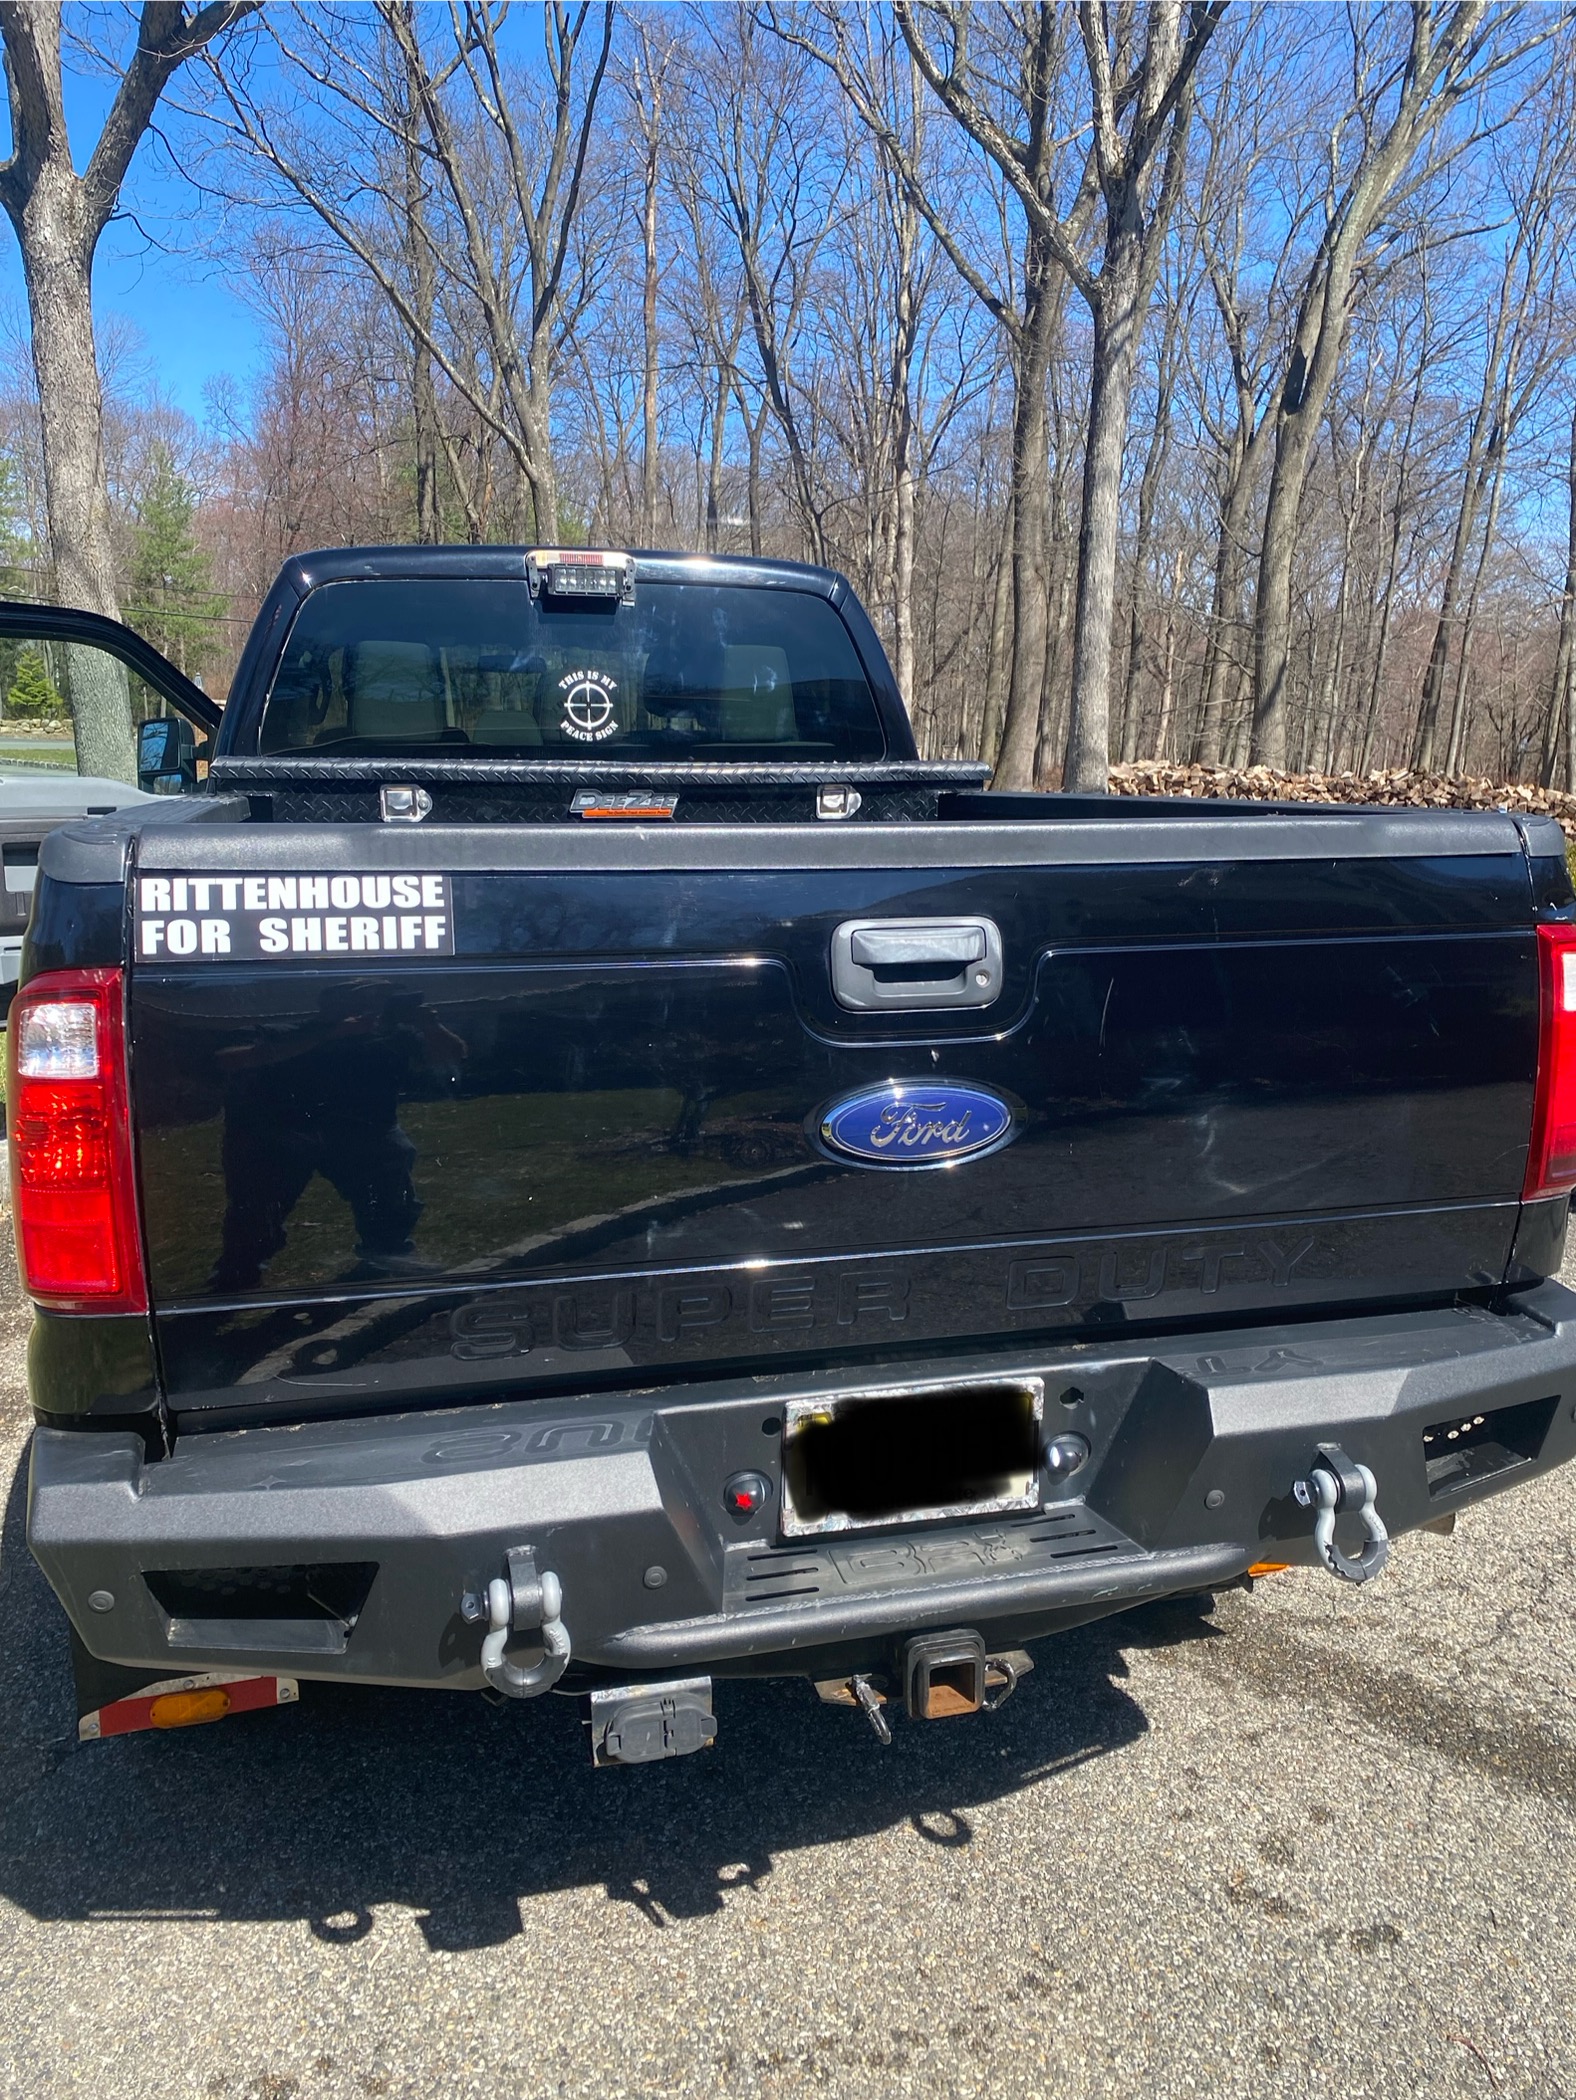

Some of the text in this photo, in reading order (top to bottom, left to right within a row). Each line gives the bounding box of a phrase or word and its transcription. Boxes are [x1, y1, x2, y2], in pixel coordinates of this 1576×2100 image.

[558, 670, 618, 690] THIS IS MY
[560, 720, 619, 742] PEACE SIGN
[141, 875, 445, 912] RITTENHOUSE
[141, 915, 447, 955] FOR SHERIFF
[871, 1102, 972, 1148] Ford
[448, 1235, 1315, 1362] SUPER DUTY
